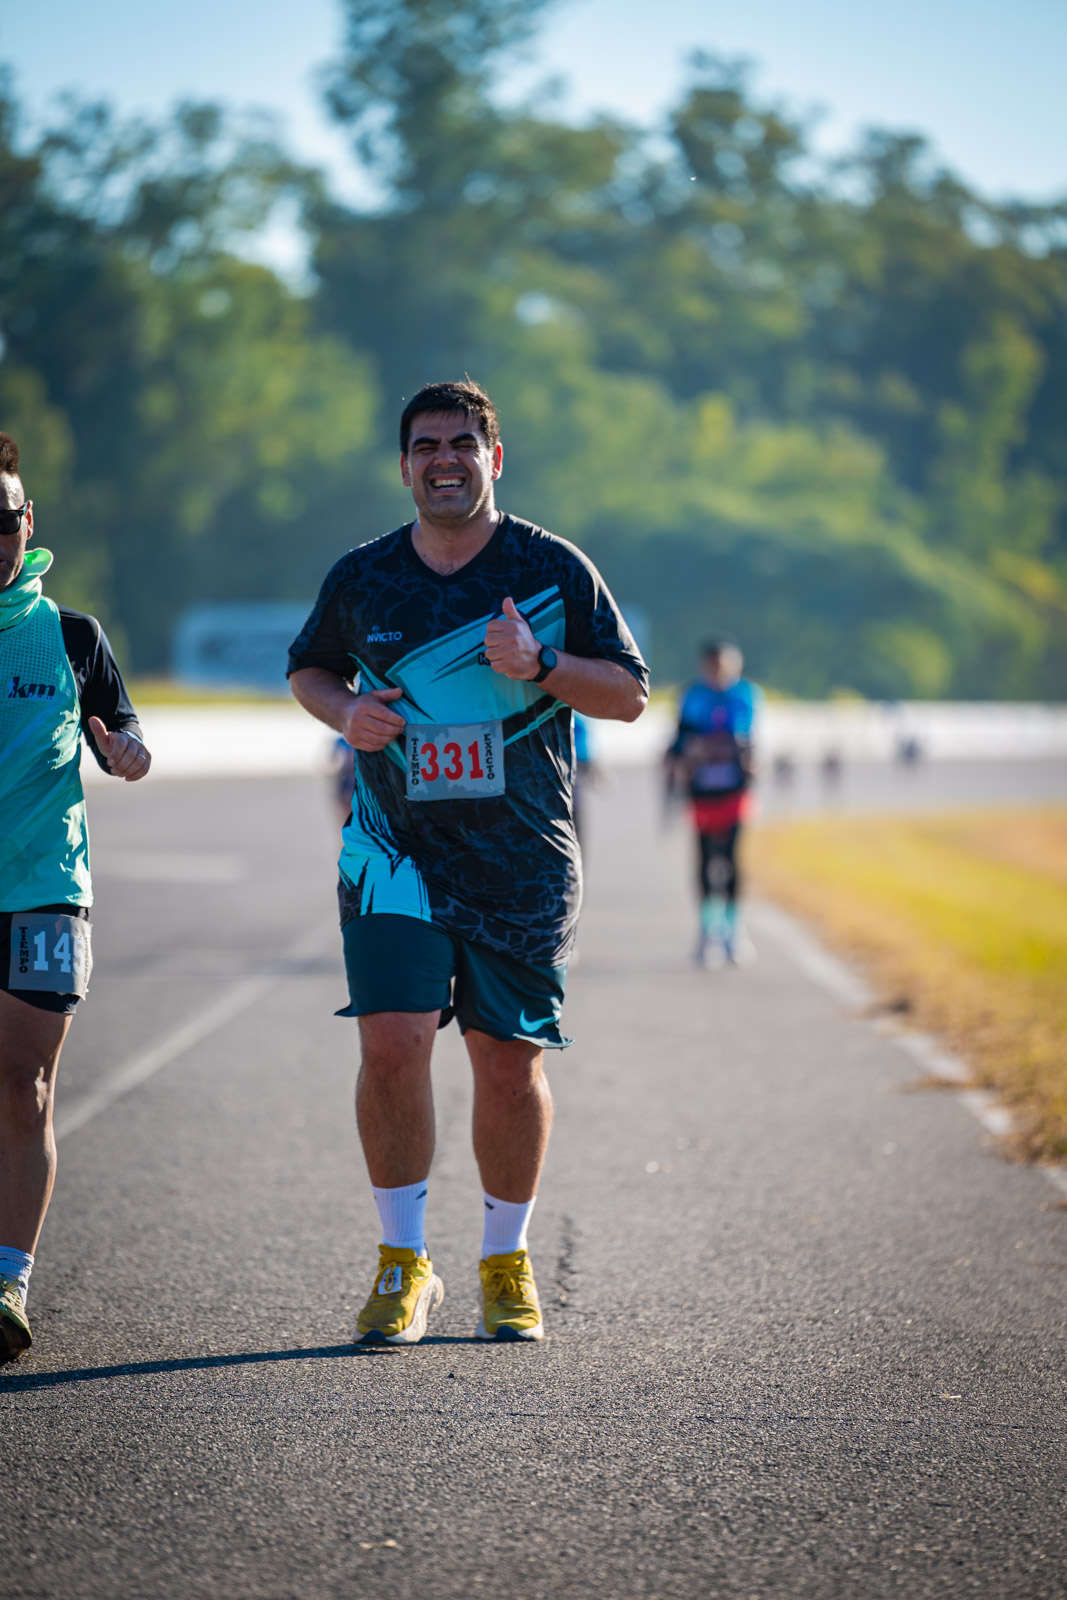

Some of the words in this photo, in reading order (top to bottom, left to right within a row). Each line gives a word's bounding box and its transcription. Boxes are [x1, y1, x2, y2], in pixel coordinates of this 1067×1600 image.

[411, 738, 420, 785] TIEMPO
[420, 740, 484, 782] 331
[483, 733, 495, 780] EXACTO
[18, 926, 29, 974] TIEMPO
